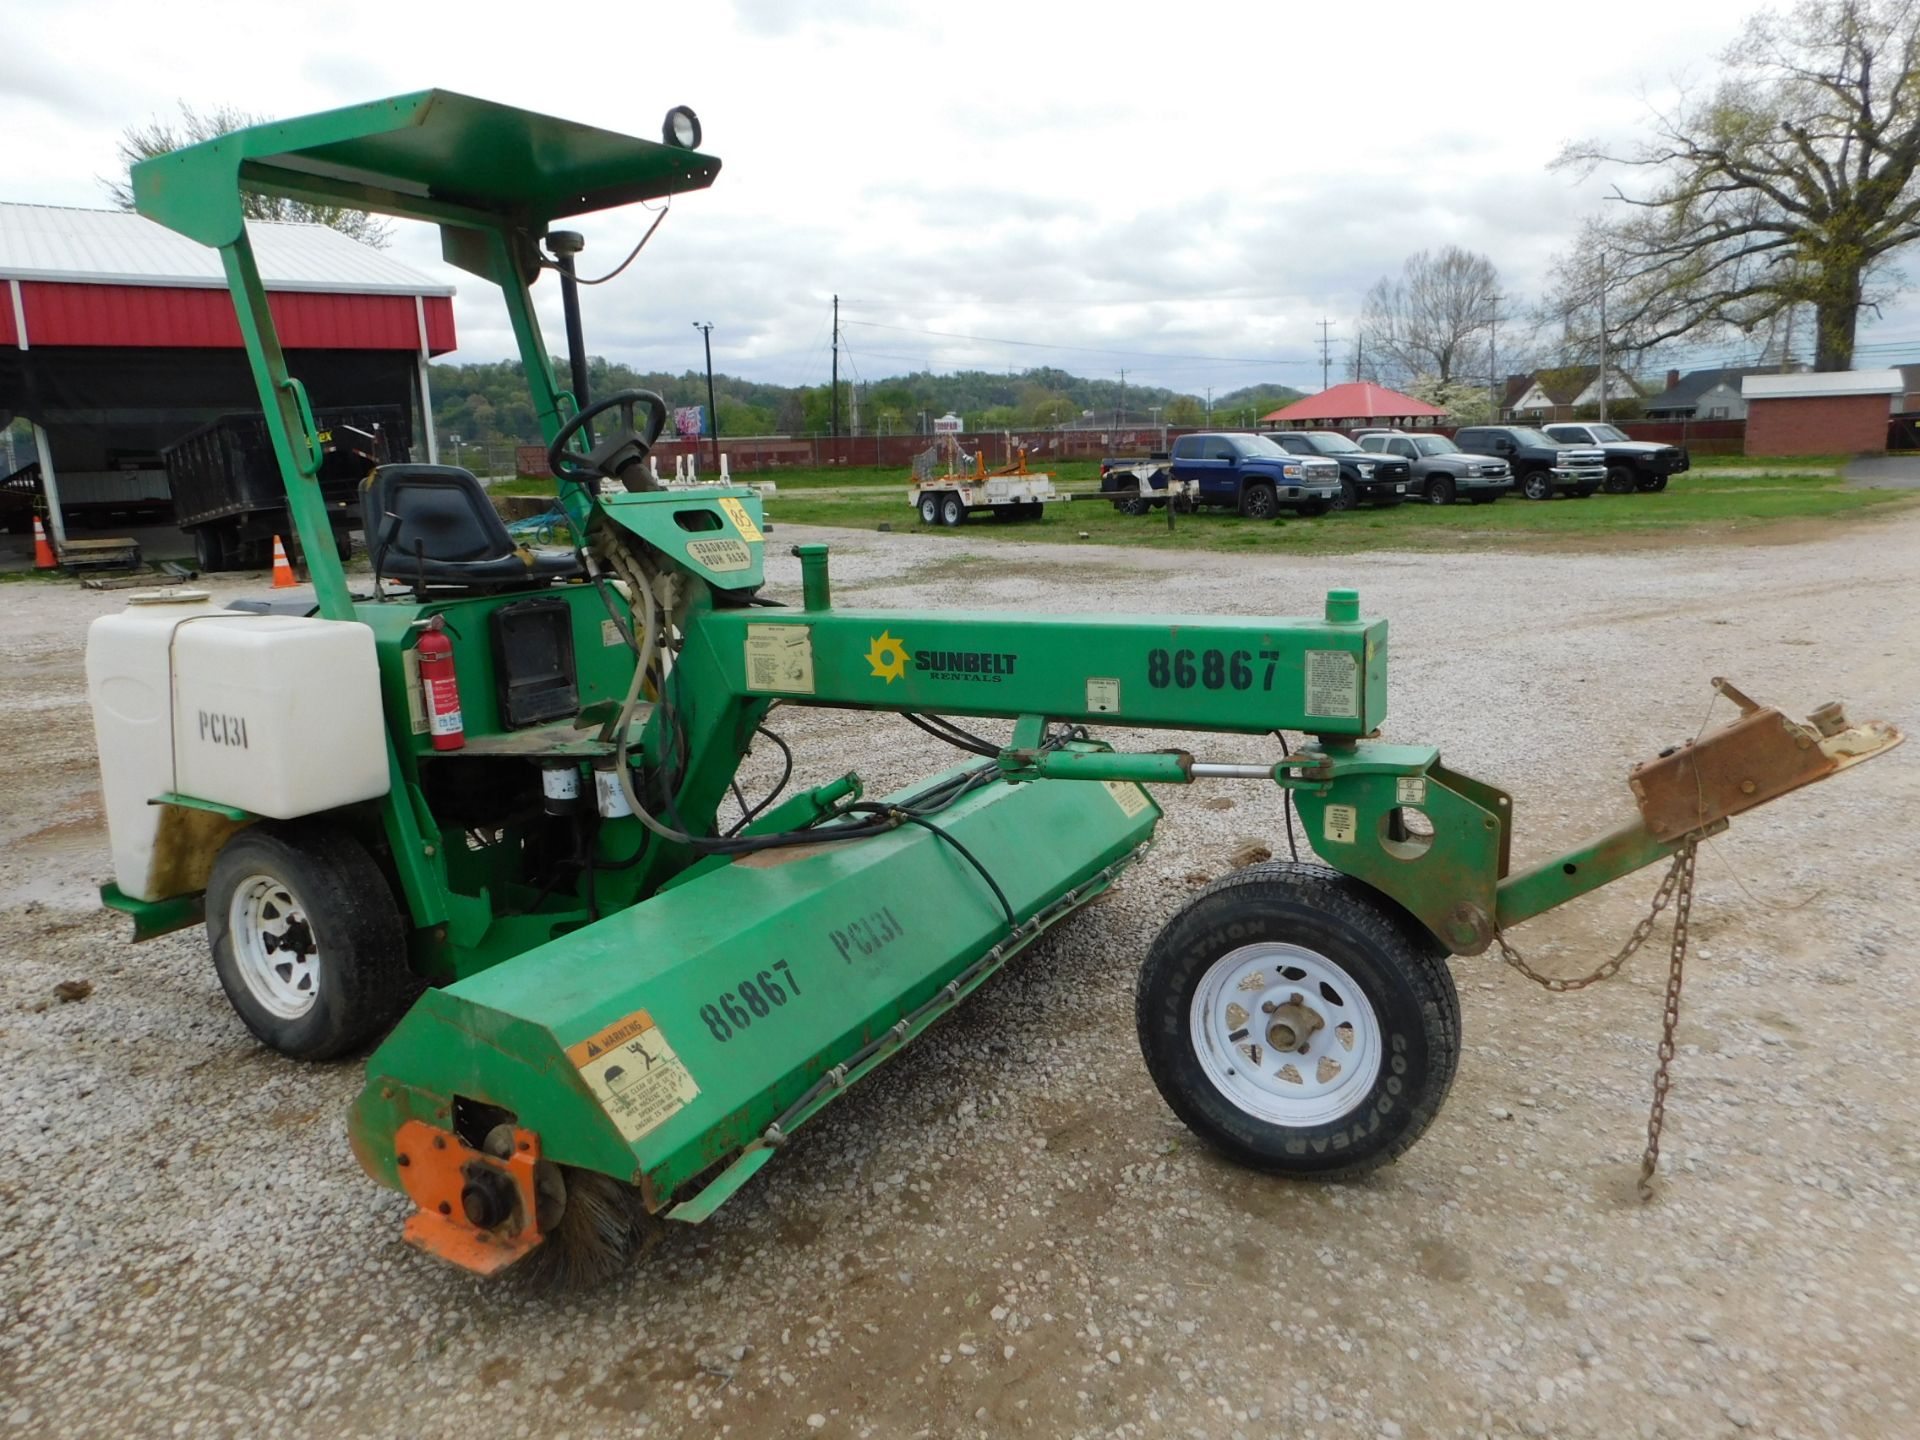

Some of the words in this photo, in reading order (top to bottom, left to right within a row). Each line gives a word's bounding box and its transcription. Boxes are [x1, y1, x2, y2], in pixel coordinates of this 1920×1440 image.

[730, 508, 752, 527] 85
[915, 650, 1017, 675] SUNBELT
[1148, 648, 1280, 691] 86867
[930, 672, 1002, 683] RENTALS
[699, 958, 802, 1043] 86867
[601, 1019, 643, 1048] WARNING
[1284, 1032, 1408, 1155] GOODYEAR
